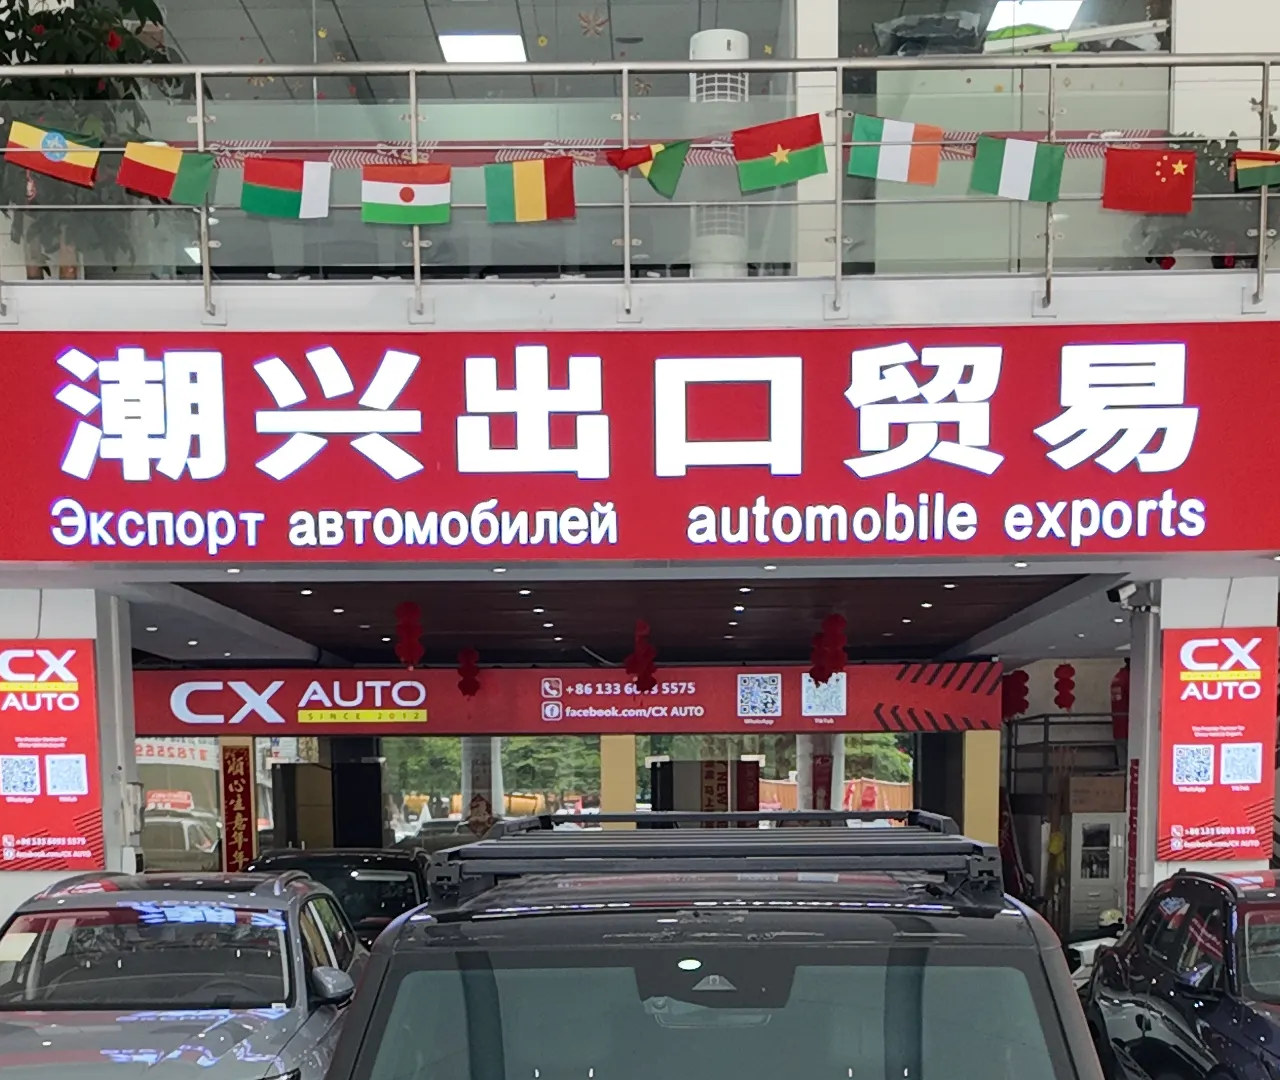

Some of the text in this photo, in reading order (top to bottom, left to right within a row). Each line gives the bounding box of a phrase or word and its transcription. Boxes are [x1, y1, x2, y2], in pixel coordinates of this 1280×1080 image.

[56, 343, 1198, 480] 潮兴出口贸易
[52, 499, 617, 554] Экспорт автомобилей
[688, 488, 1206, 548] automobile exports
[1179, 637, 1262, 671] CX
[169, 680, 286, 724] CX
[297, 680, 426, 708] AUTO
[566, 683, 592, 694] +86
[596, 683, 620, 694] 133
[662, 682, 695, 694] 5575
[1180, 681, 1261, 701] AUTO
[1, 693, 80, 712] AUTO
[308, 712, 421, 720] SINCE 2012
[565, 705, 705, 719] facebook.com/CX AUTO
